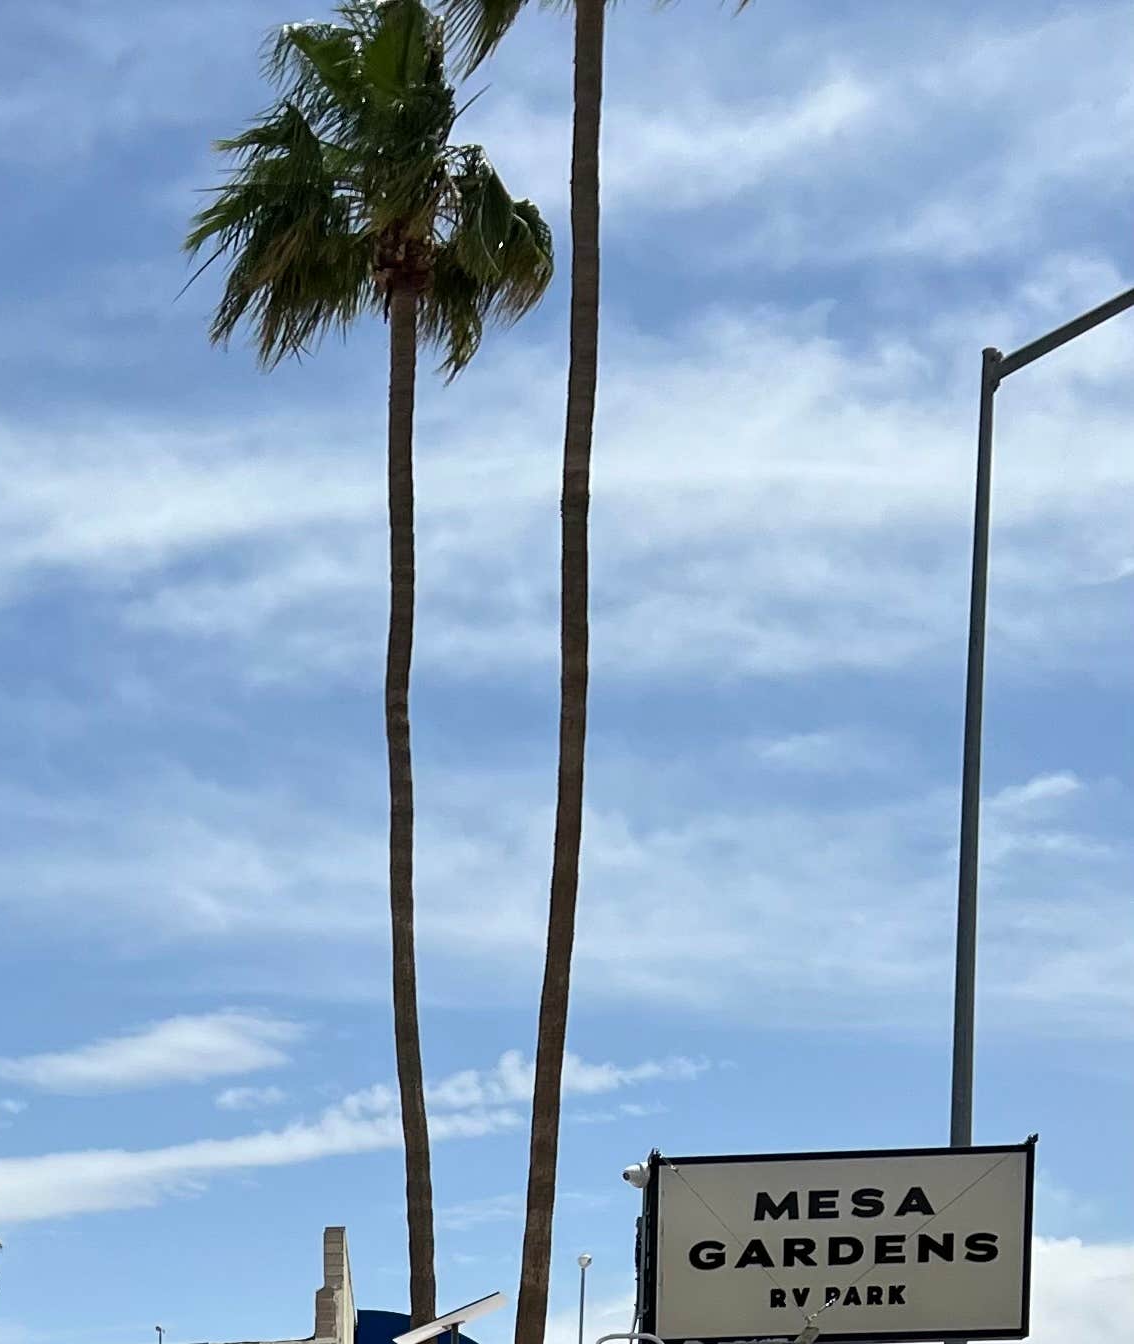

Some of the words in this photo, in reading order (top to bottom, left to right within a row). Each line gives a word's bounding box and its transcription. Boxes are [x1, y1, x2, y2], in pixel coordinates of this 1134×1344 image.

[754, 1186, 936, 1222] MESA
[688, 1232, 1000, 1270] GARDENS
[770, 1287, 811, 1309] RV
[825, 1285, 907, 1309] PARK
